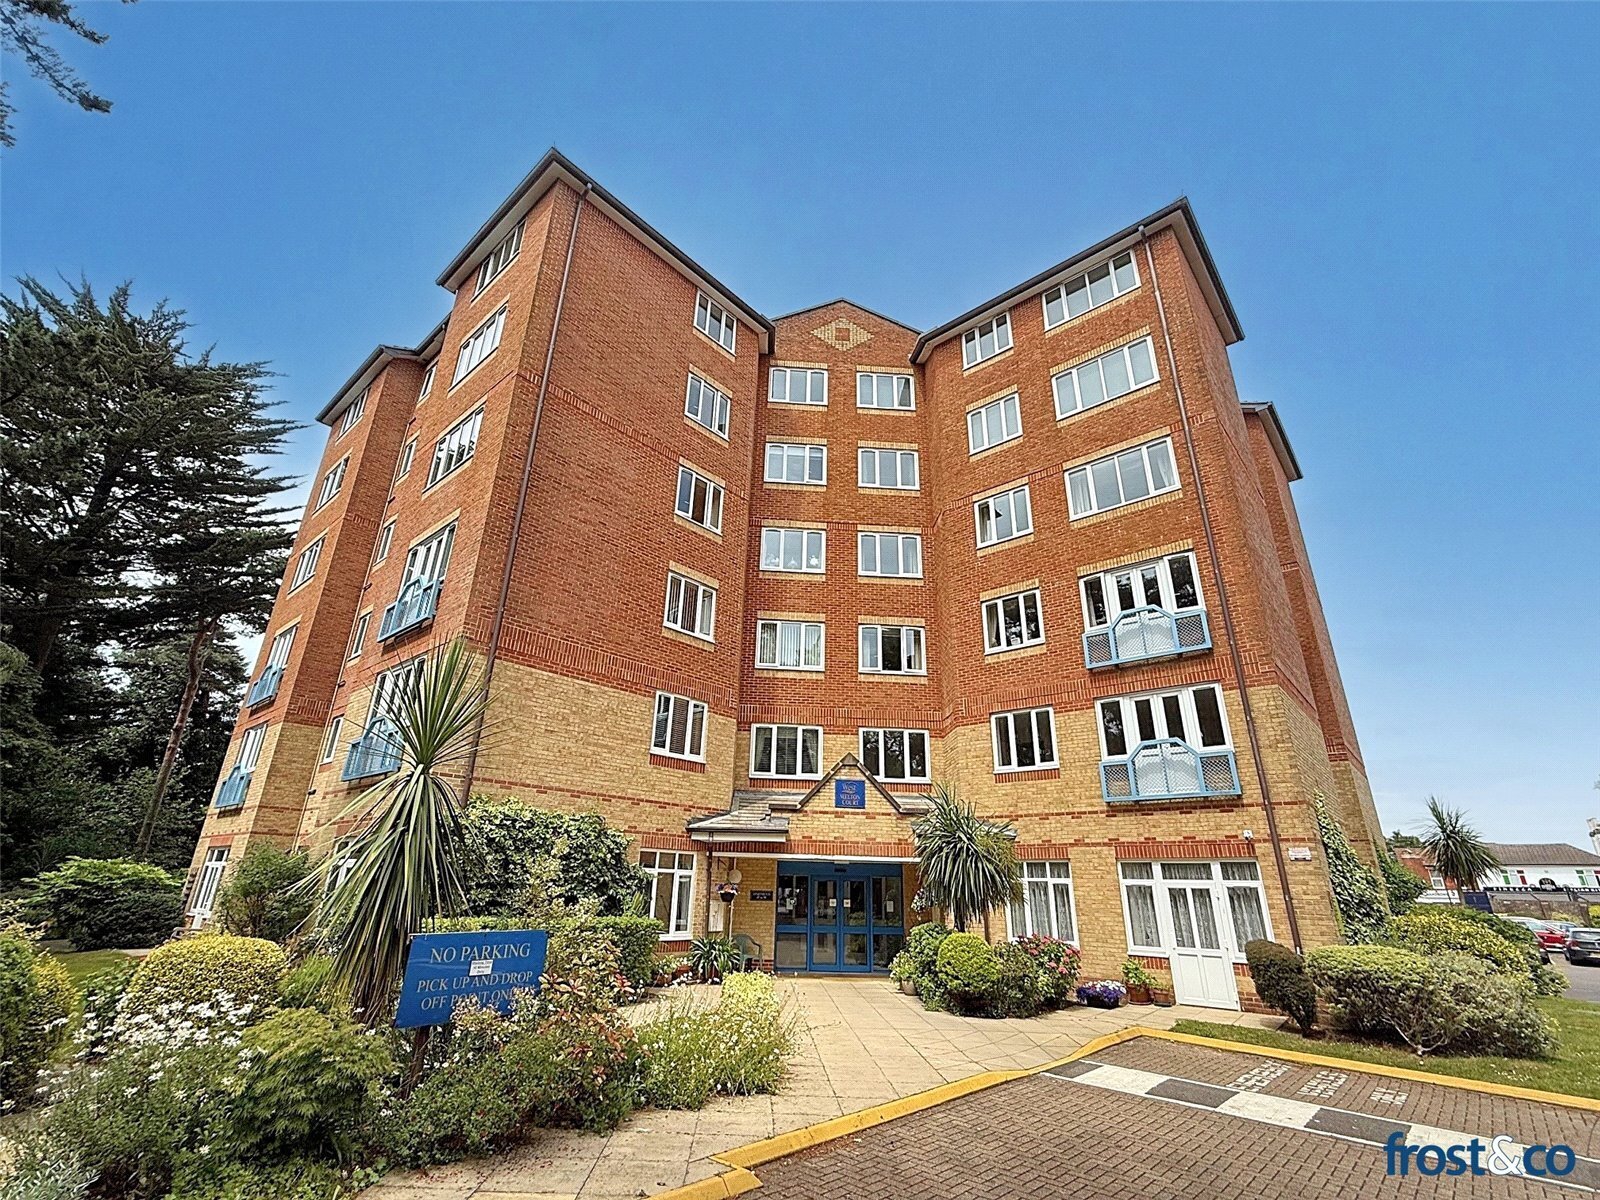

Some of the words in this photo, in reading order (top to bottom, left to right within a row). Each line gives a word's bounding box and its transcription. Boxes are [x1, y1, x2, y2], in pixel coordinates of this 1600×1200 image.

[430, 947, 456, 963] NO
[460, 943, 531, 962] PARKING
[416, 979, 449, 993] PICK
[452, 977, 469, 989] UP
[471, 974, 499, 987] AND
[501, 971, 533, 984] DROP
[421, 996, 448, 1010] OFF
